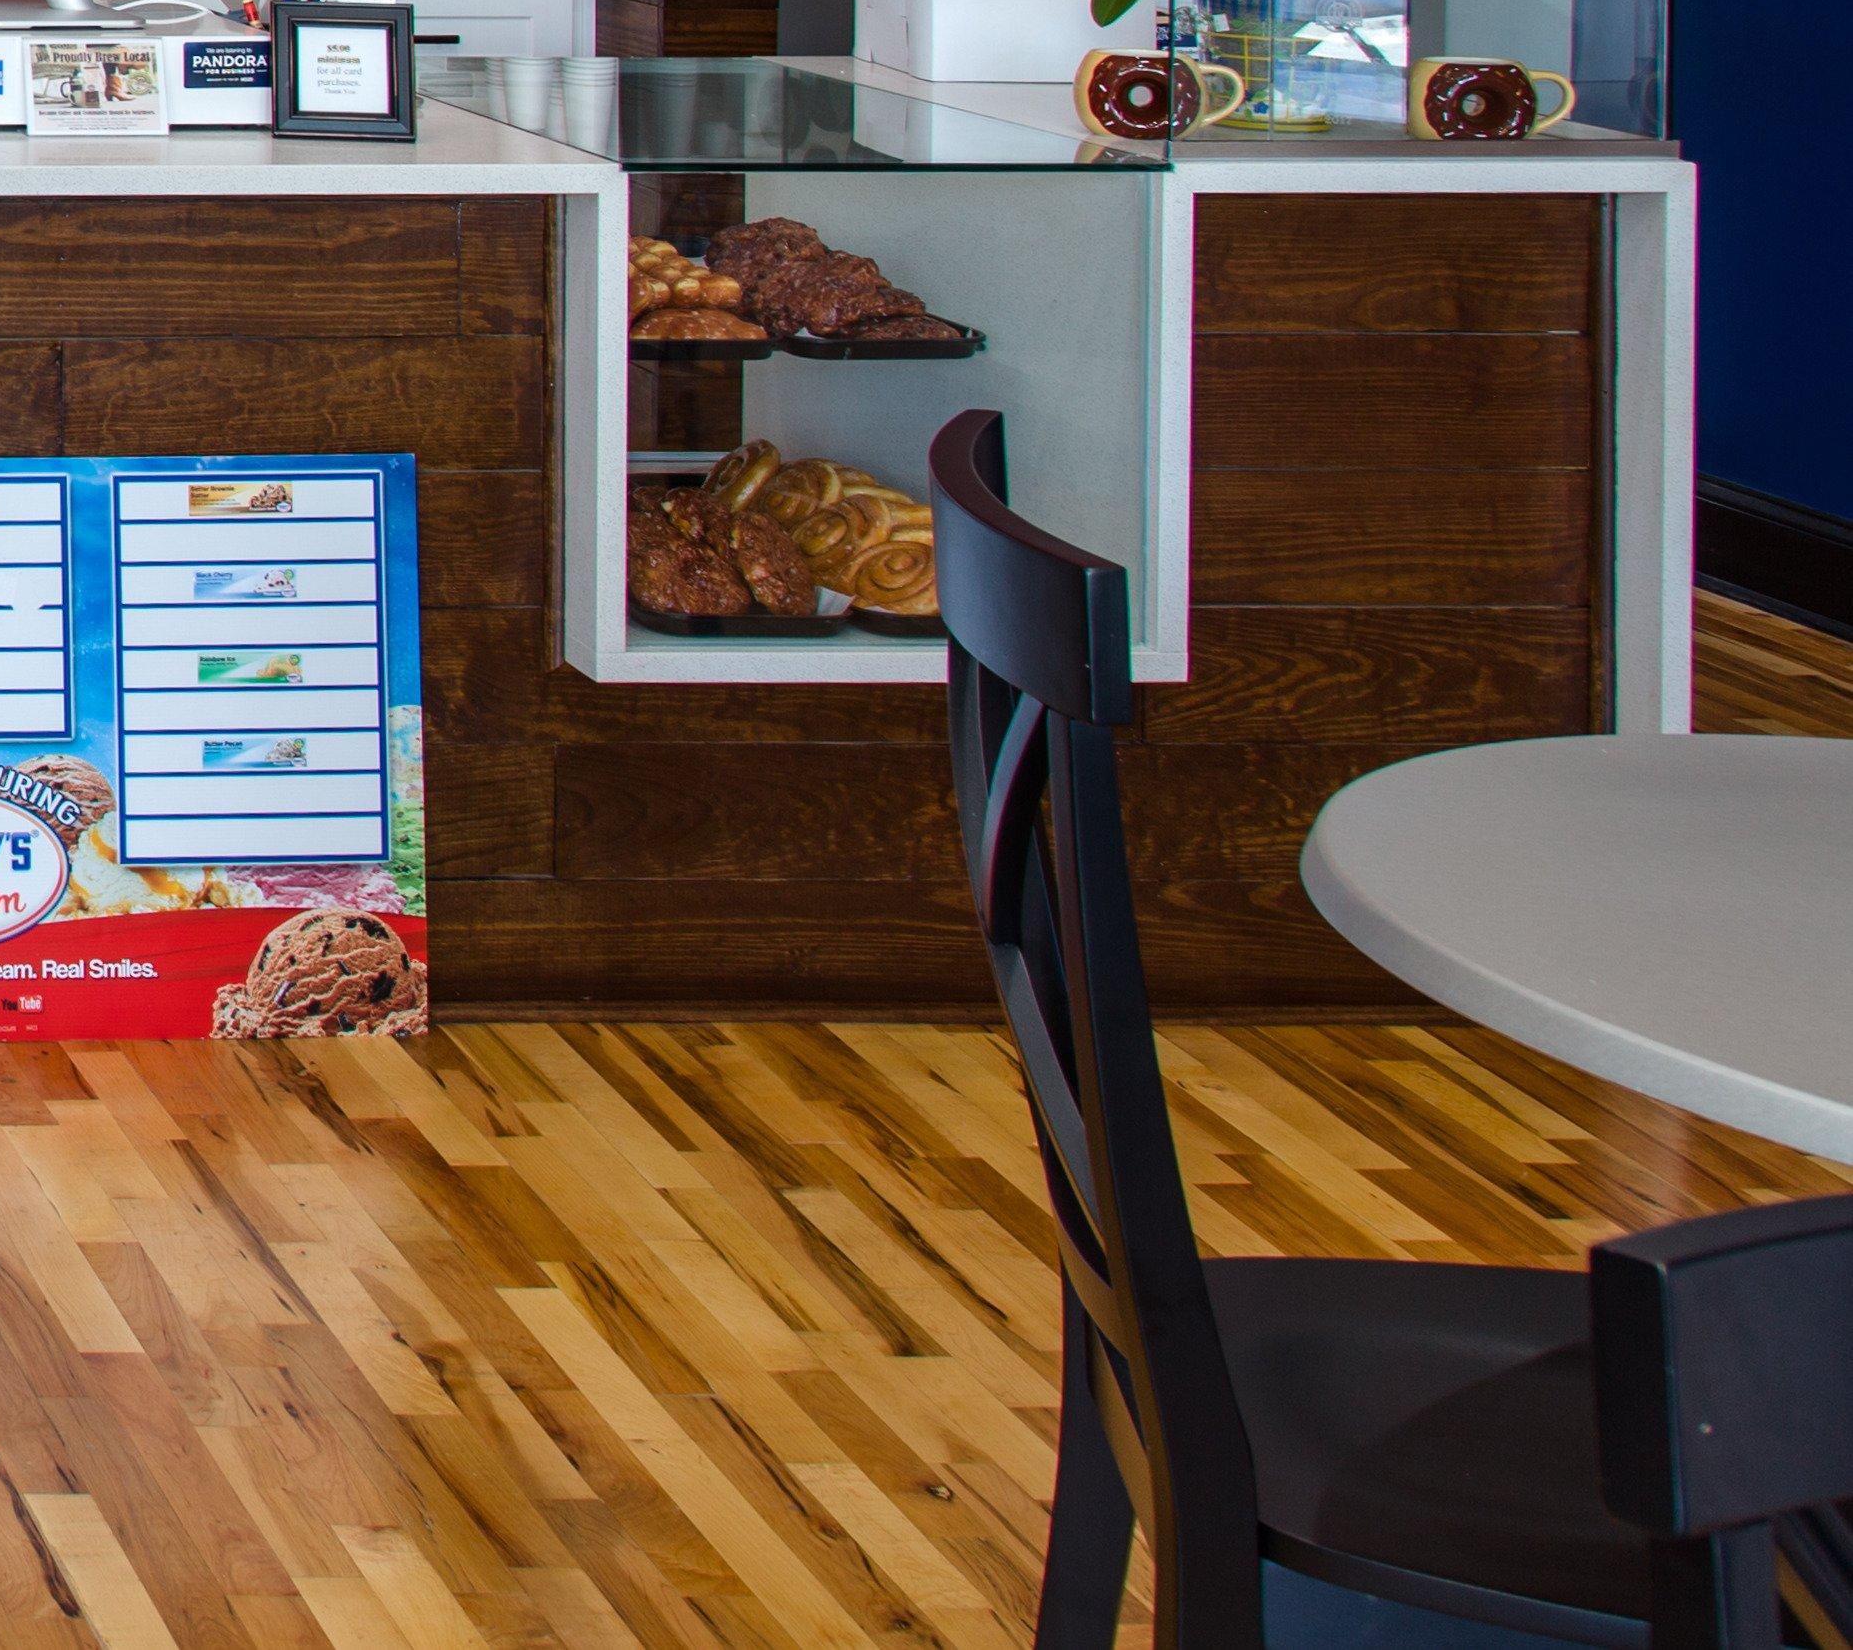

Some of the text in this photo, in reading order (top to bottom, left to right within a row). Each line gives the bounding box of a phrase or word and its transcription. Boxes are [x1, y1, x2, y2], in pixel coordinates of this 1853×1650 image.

[35, 51, 150, 63] We Proudly Brew Local
[193, 55, 267, 67] PANDORA
[317, 56, 361, 64] minimum
[317, 67, 362, 75] for all card
[317, 78, 361, 88] purchases.
[41, 959, 85, 980] Real
[88, 958, 159, 980] Smiles.
